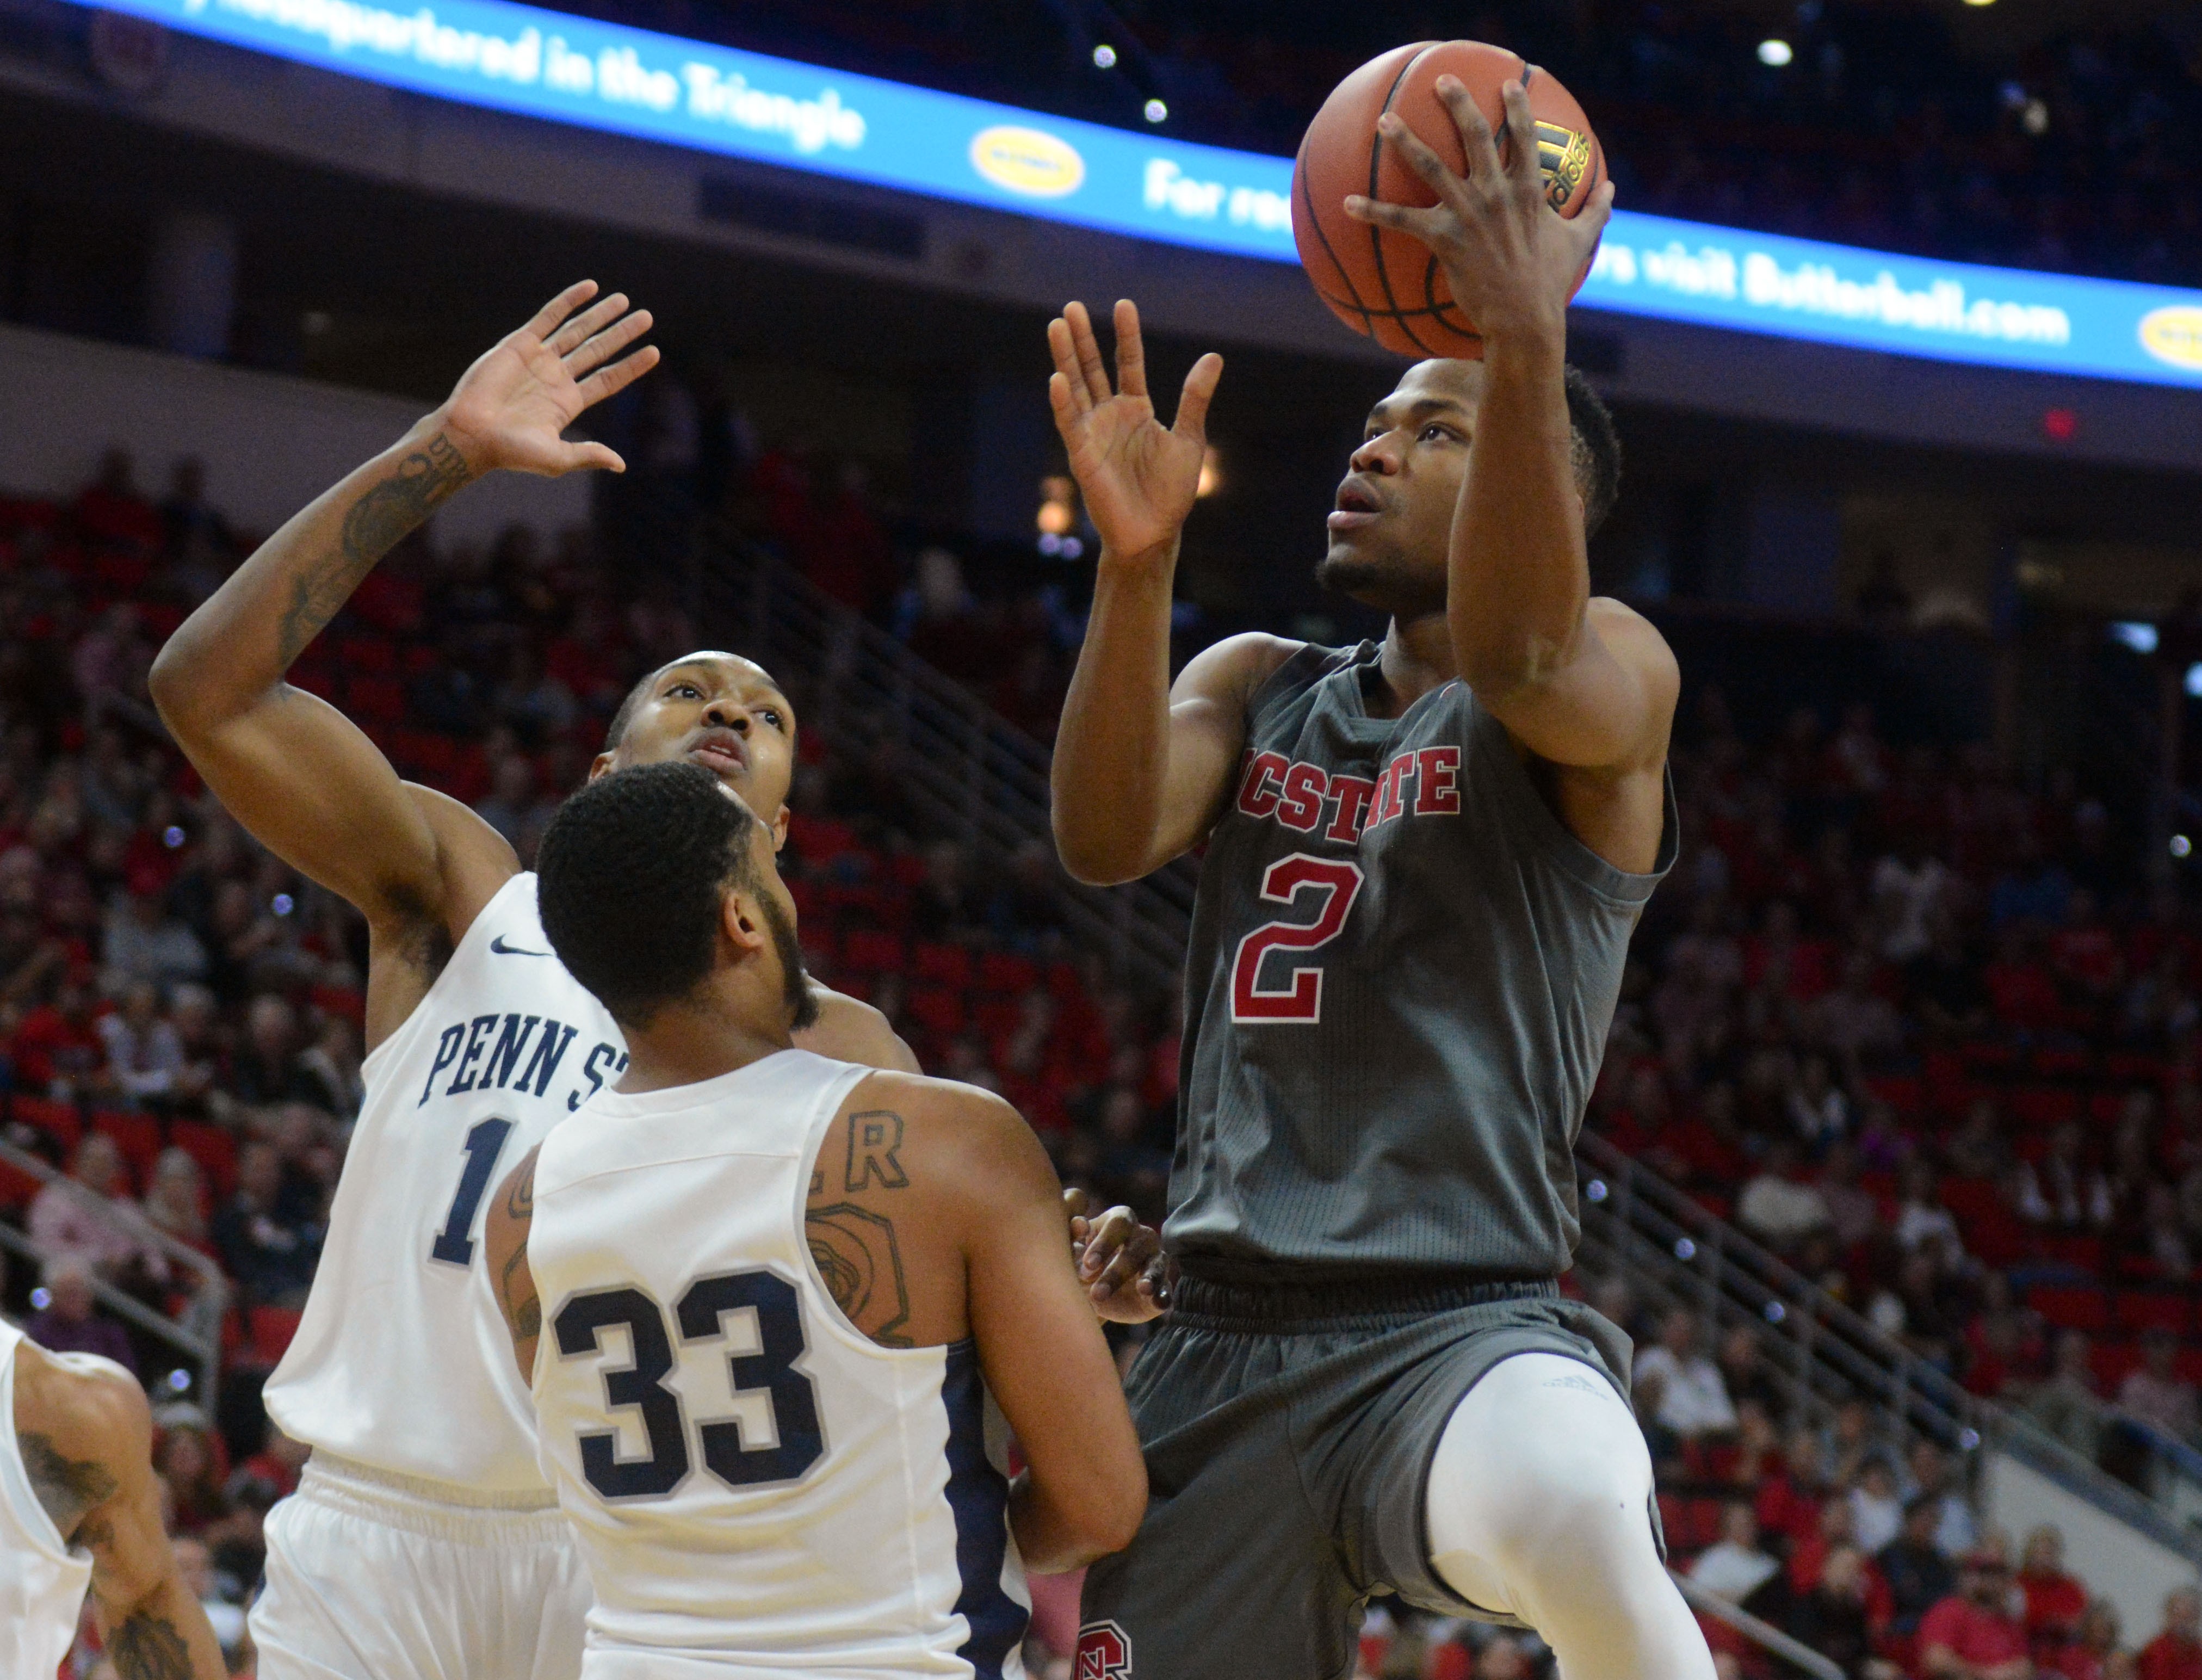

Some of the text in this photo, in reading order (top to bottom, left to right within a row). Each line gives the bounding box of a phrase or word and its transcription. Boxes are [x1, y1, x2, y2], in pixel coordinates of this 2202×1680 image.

[545, 36, 594, 94] in
[599, 46, 680, 112] the
[682, 61, 865, 155] Triangle
[1145, 158, 1224, 221] For
[1642, 241, 1737, 301] visit
[1744, 252, 2070, 348] Butterball.com
[1231, 852, 1365, 1023] 2
[418, 1012, 579, 1109] PENN
[428, 1113, 519, 1271] 1
[549, 1263, 831, 1505] 33
